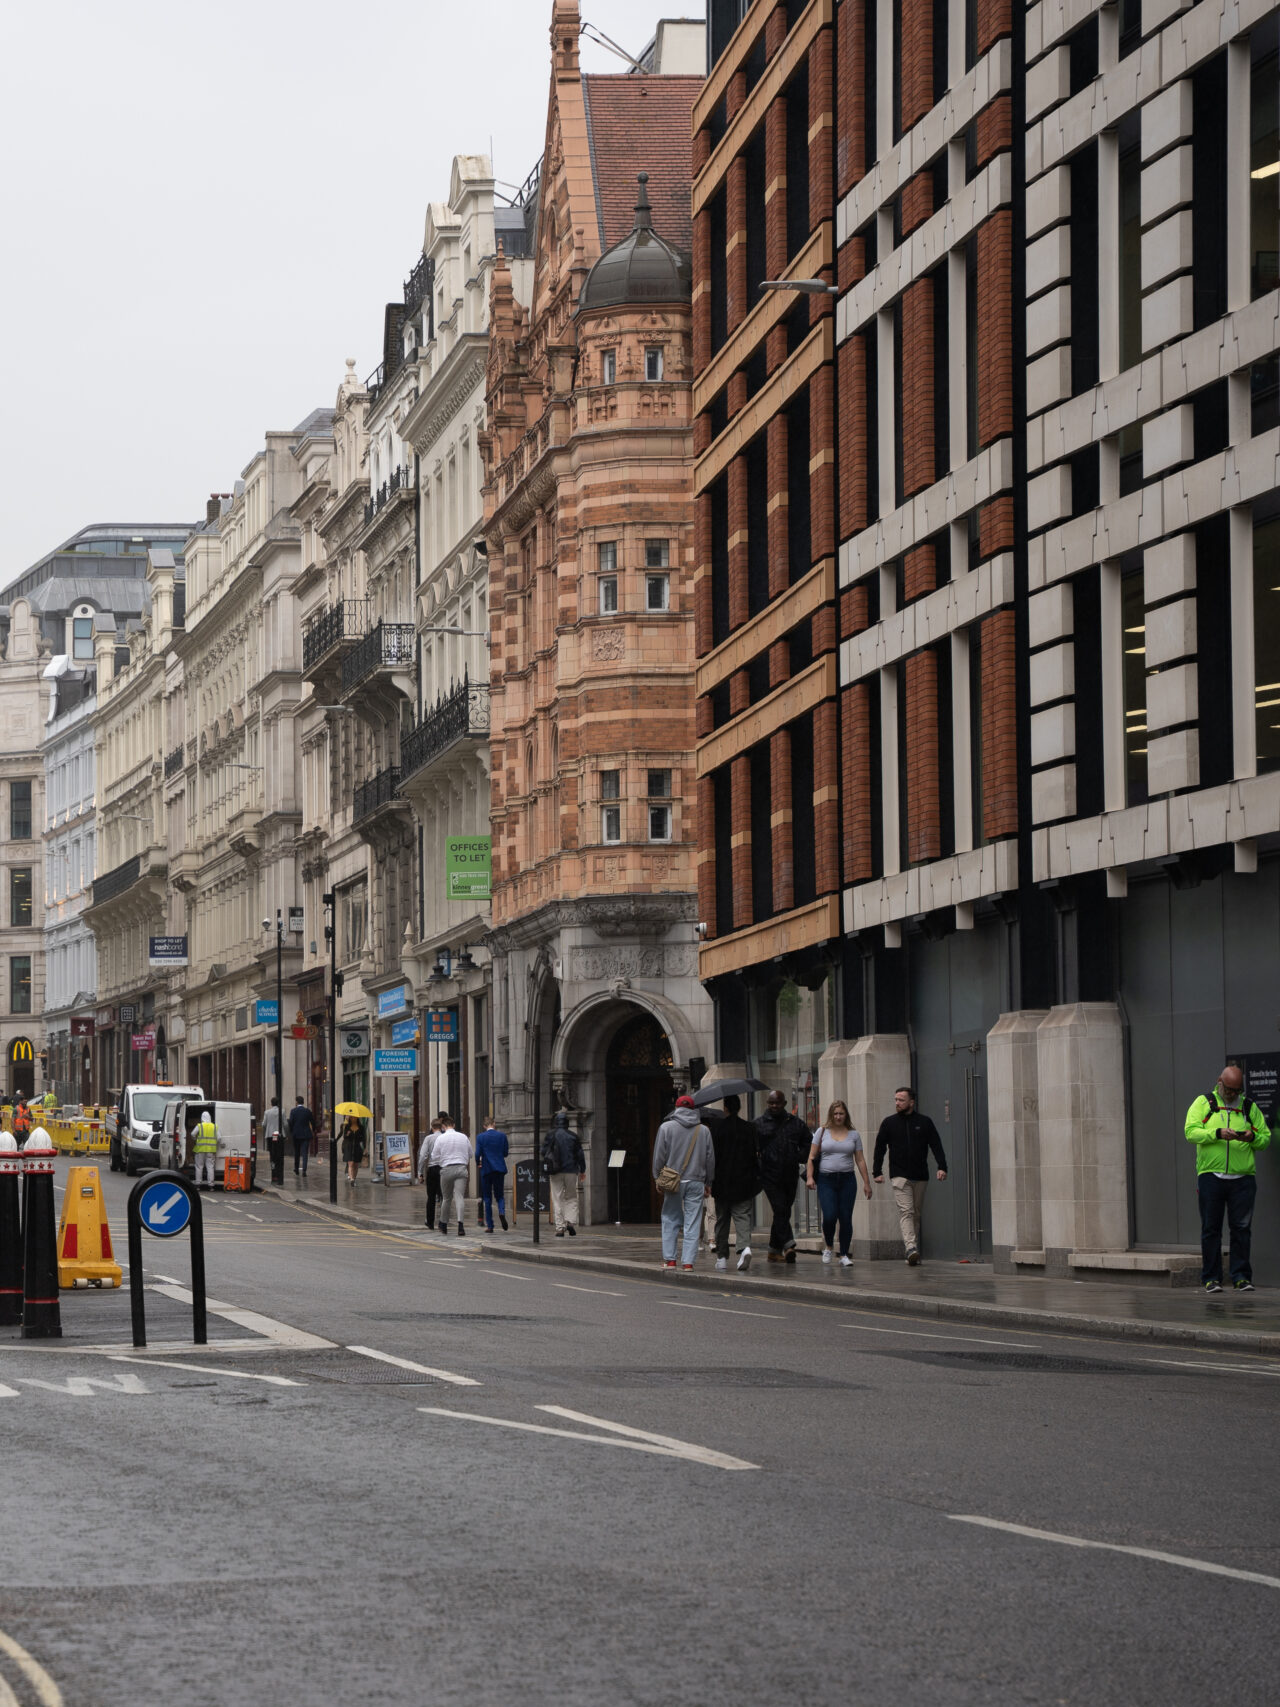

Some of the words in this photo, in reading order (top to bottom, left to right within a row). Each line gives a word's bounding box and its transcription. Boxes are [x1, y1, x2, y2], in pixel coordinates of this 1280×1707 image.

[450, 843, 489, 851] OFFICES
[453, 854, 467, 862] TO
[469, 854, 486, 862] LET
[389, 1140, 407, 1148] TASTY
